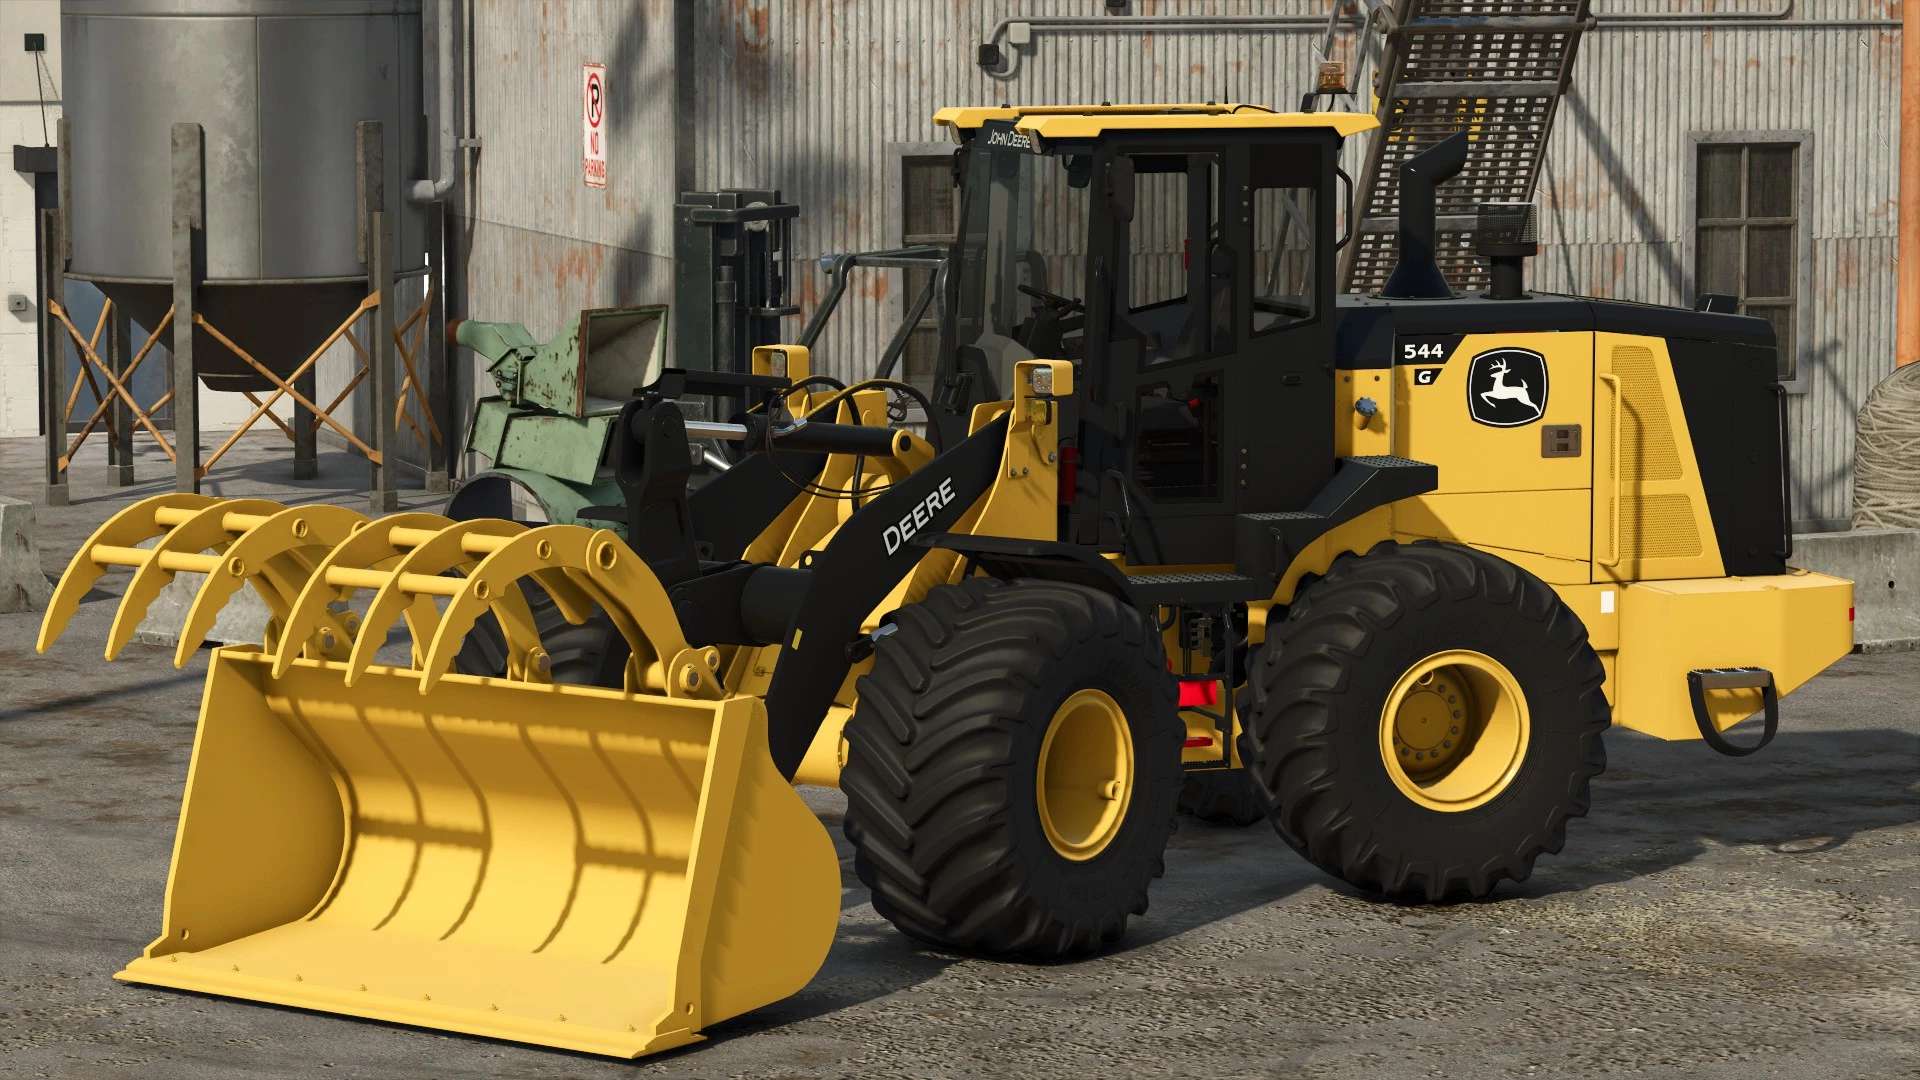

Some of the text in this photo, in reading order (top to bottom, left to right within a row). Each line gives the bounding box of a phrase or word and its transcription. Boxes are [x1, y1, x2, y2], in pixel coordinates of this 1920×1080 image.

[590, 131, 599, 155] NO
[987, 129, 1031, 149] JOHN DEERE
[585, 158, 605, 178] PARKING
[1404, 343, 1444, 359] 544
[1418, 370, 1432, 384] G
[882, 476, 956, 556] DEERE
